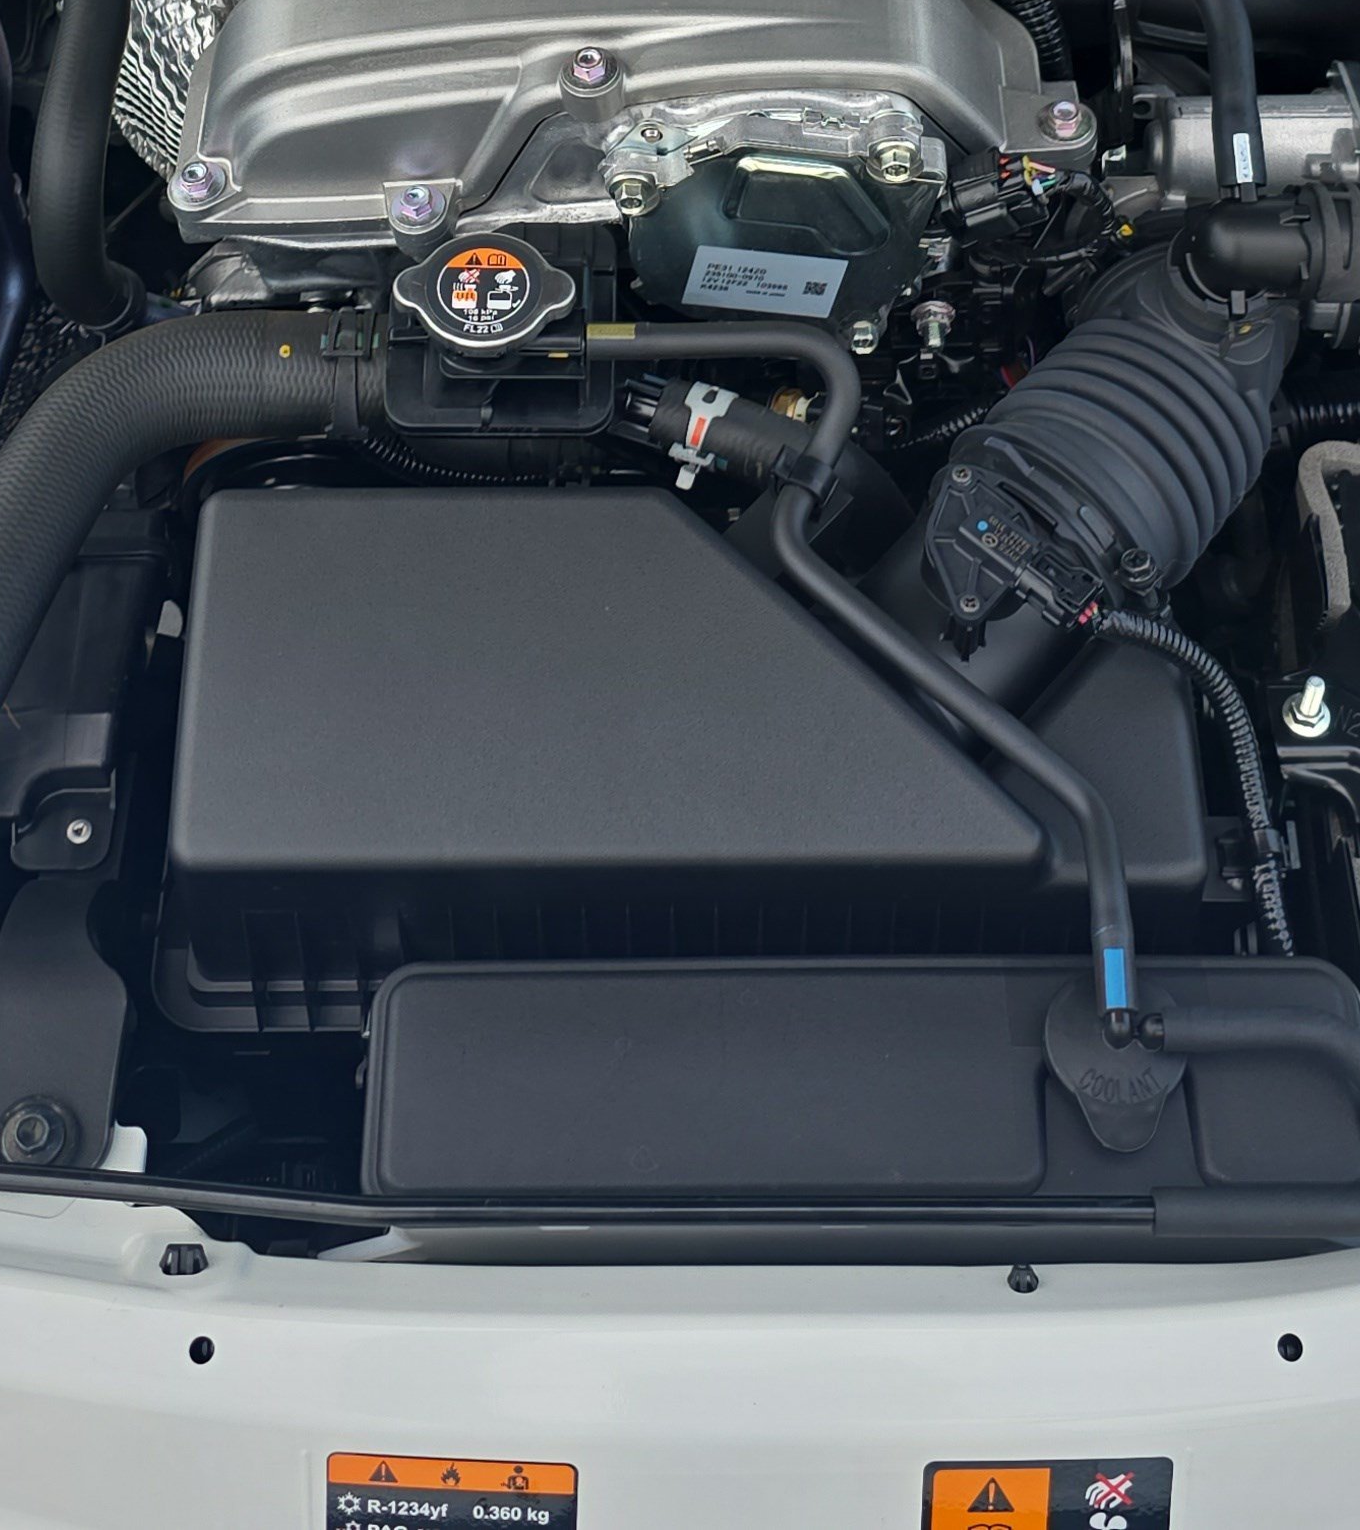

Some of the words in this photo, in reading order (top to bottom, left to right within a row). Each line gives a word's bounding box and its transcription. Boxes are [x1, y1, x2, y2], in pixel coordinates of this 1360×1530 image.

[463, 324, 489, 334] FL22
[1078, 1066, 1163, 1104] COOLANT
[367, 1499, 449, 1519] R-1234yf
[473, 1505, 522, 1521] 0.360
[527, 1508, 550, 1524] kg
